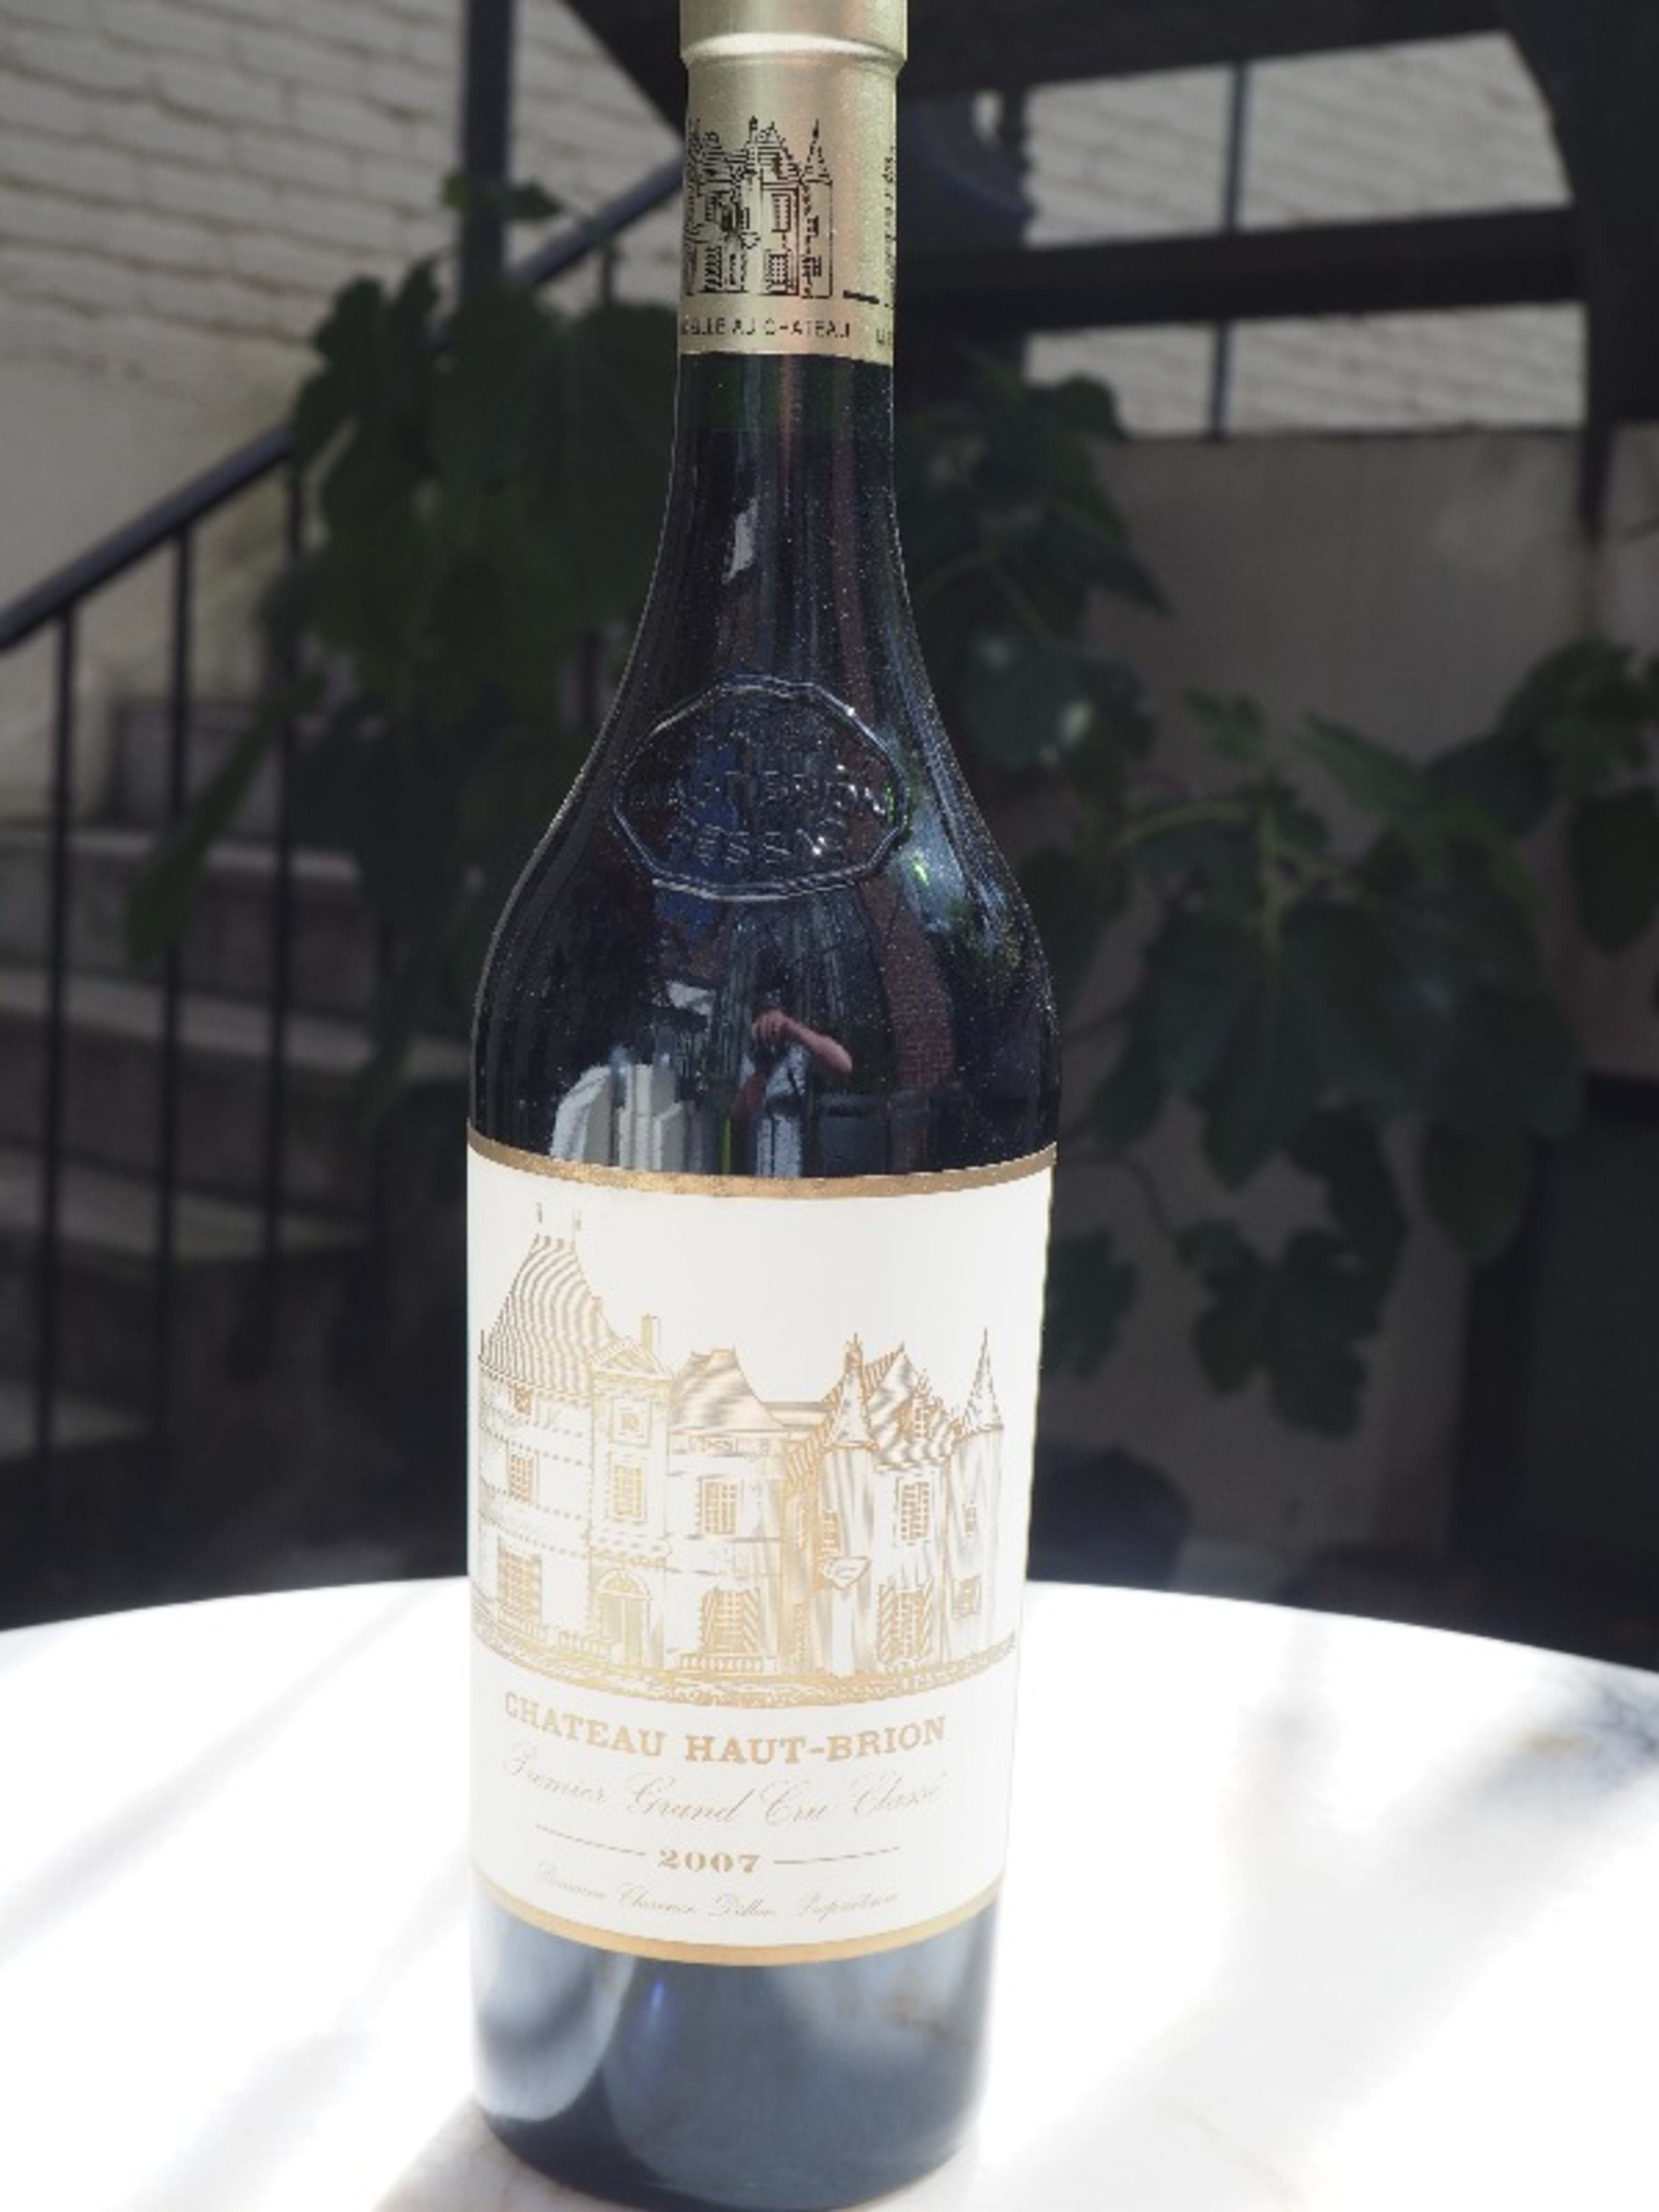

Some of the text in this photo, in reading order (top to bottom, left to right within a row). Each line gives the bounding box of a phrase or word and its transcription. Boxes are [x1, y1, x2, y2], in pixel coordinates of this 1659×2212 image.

[505, 1690, 947, 1765] CHATEAU HAUT-BRION
[503, 1741, 607, 1804] Premier
[626, 1771, 756, 1822] Grand
[760, 1779, 828, 1825] Cru
[658, 1849, 761, 1874] 2007
